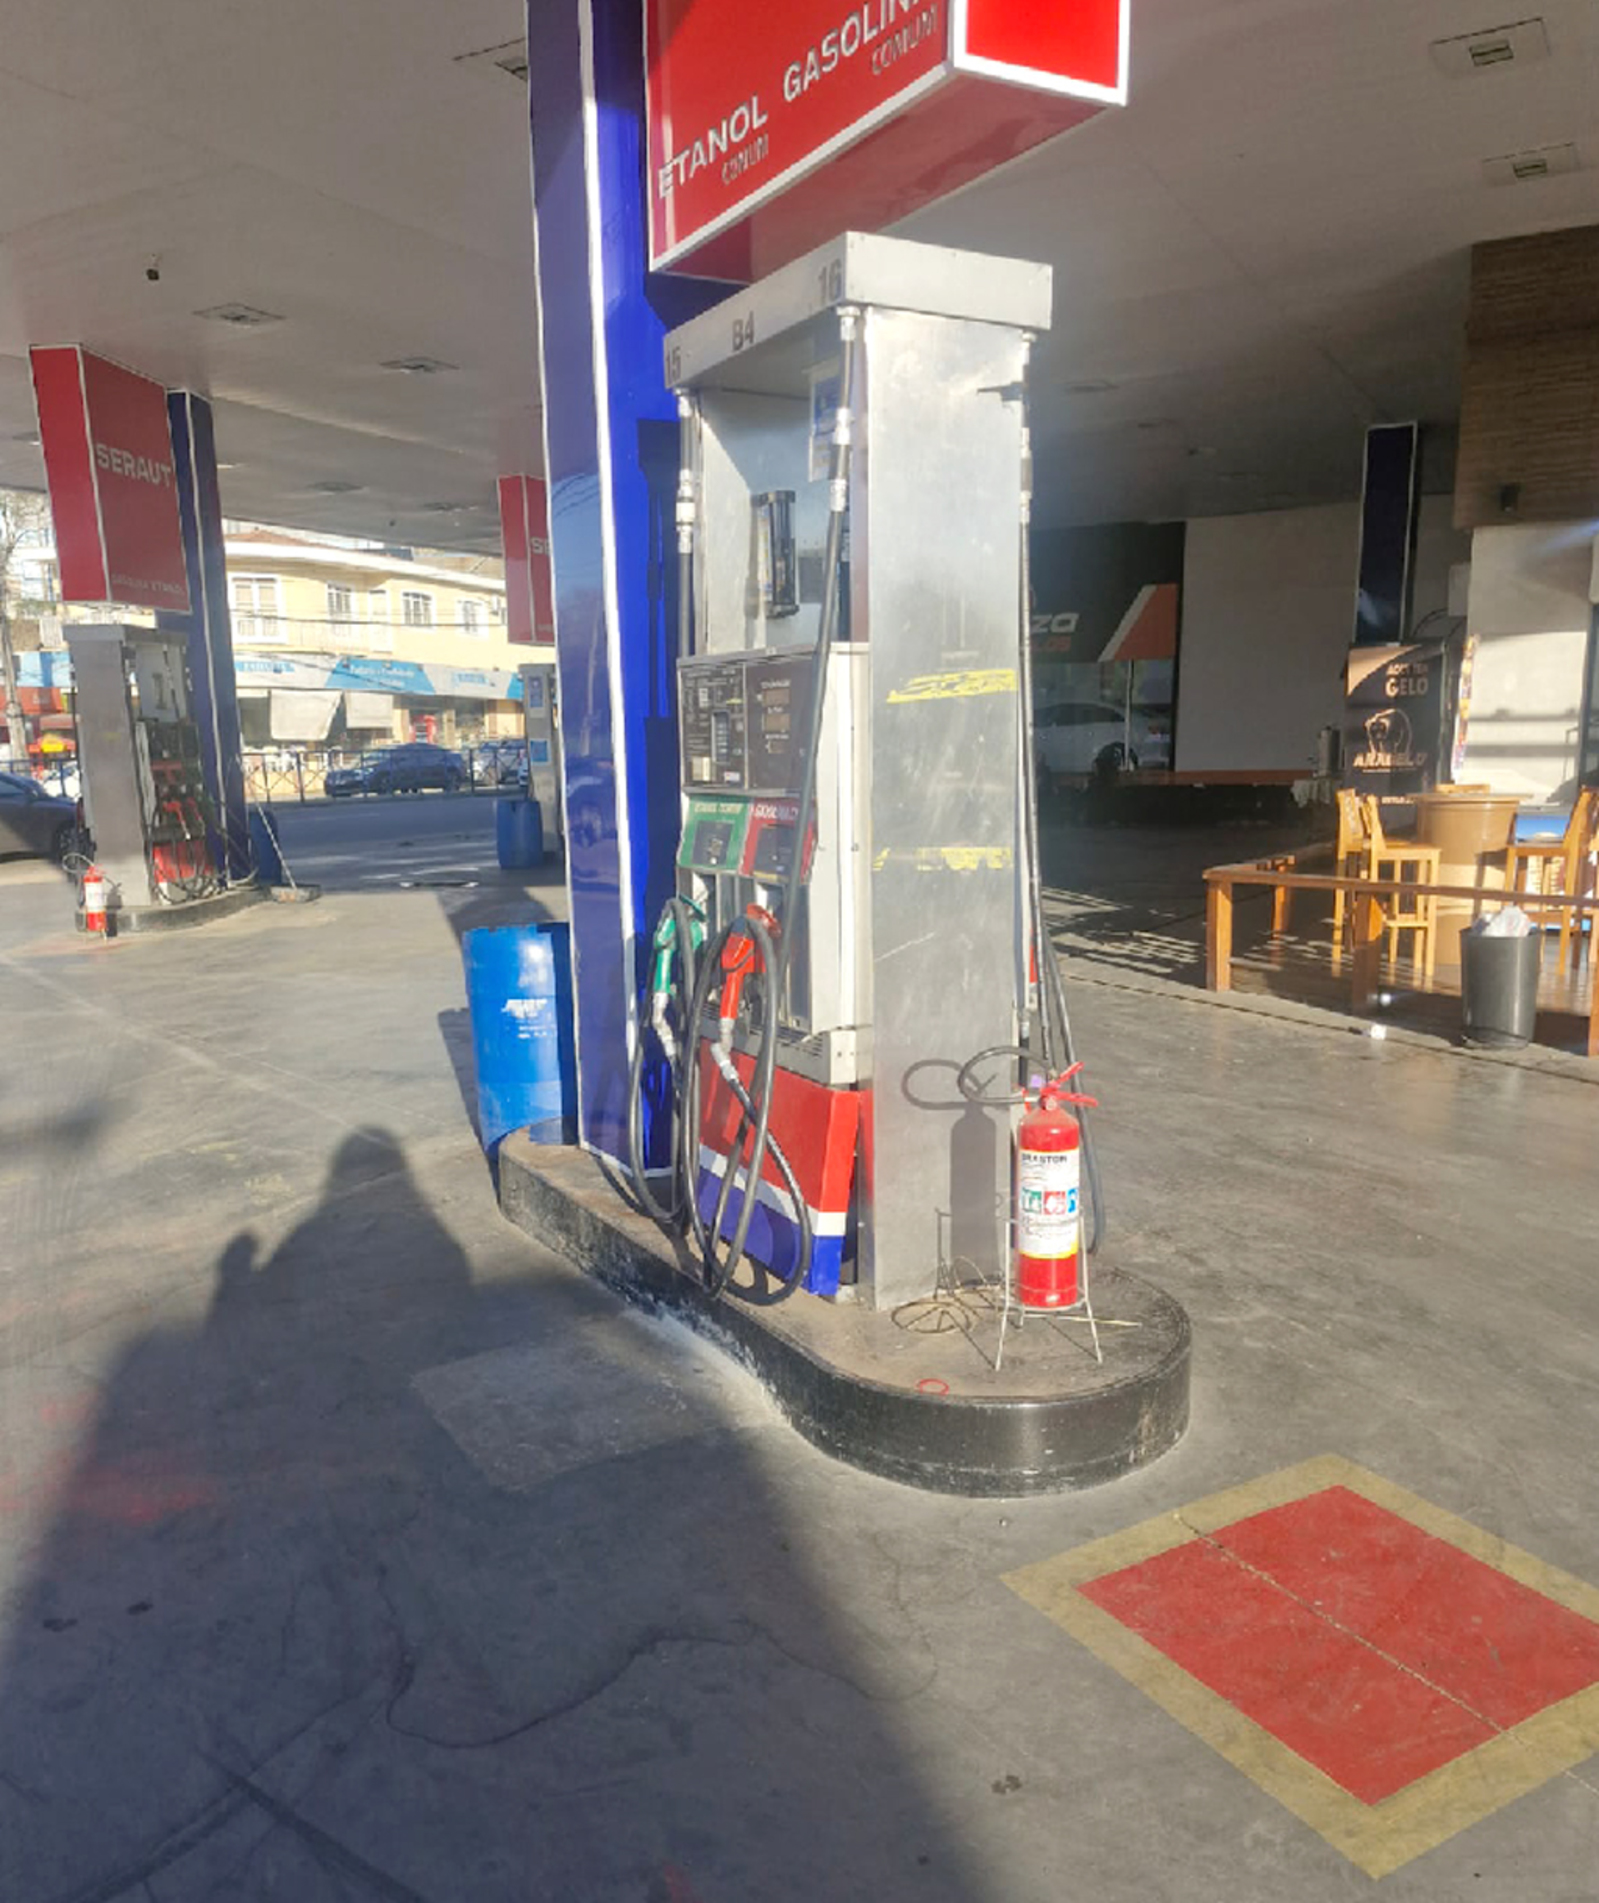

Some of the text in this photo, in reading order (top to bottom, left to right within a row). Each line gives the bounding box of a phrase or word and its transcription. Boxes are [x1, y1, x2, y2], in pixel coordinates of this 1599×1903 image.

[658, 92, 768, 199] ETANOL
[818, 258, 842, 304] 16
[731, 310, 755, 351] B4
[666, 347, 682, 388] 15
[96, 443, 172, 488] SERAUT
[1385, 677, 1429, 698] GELO
